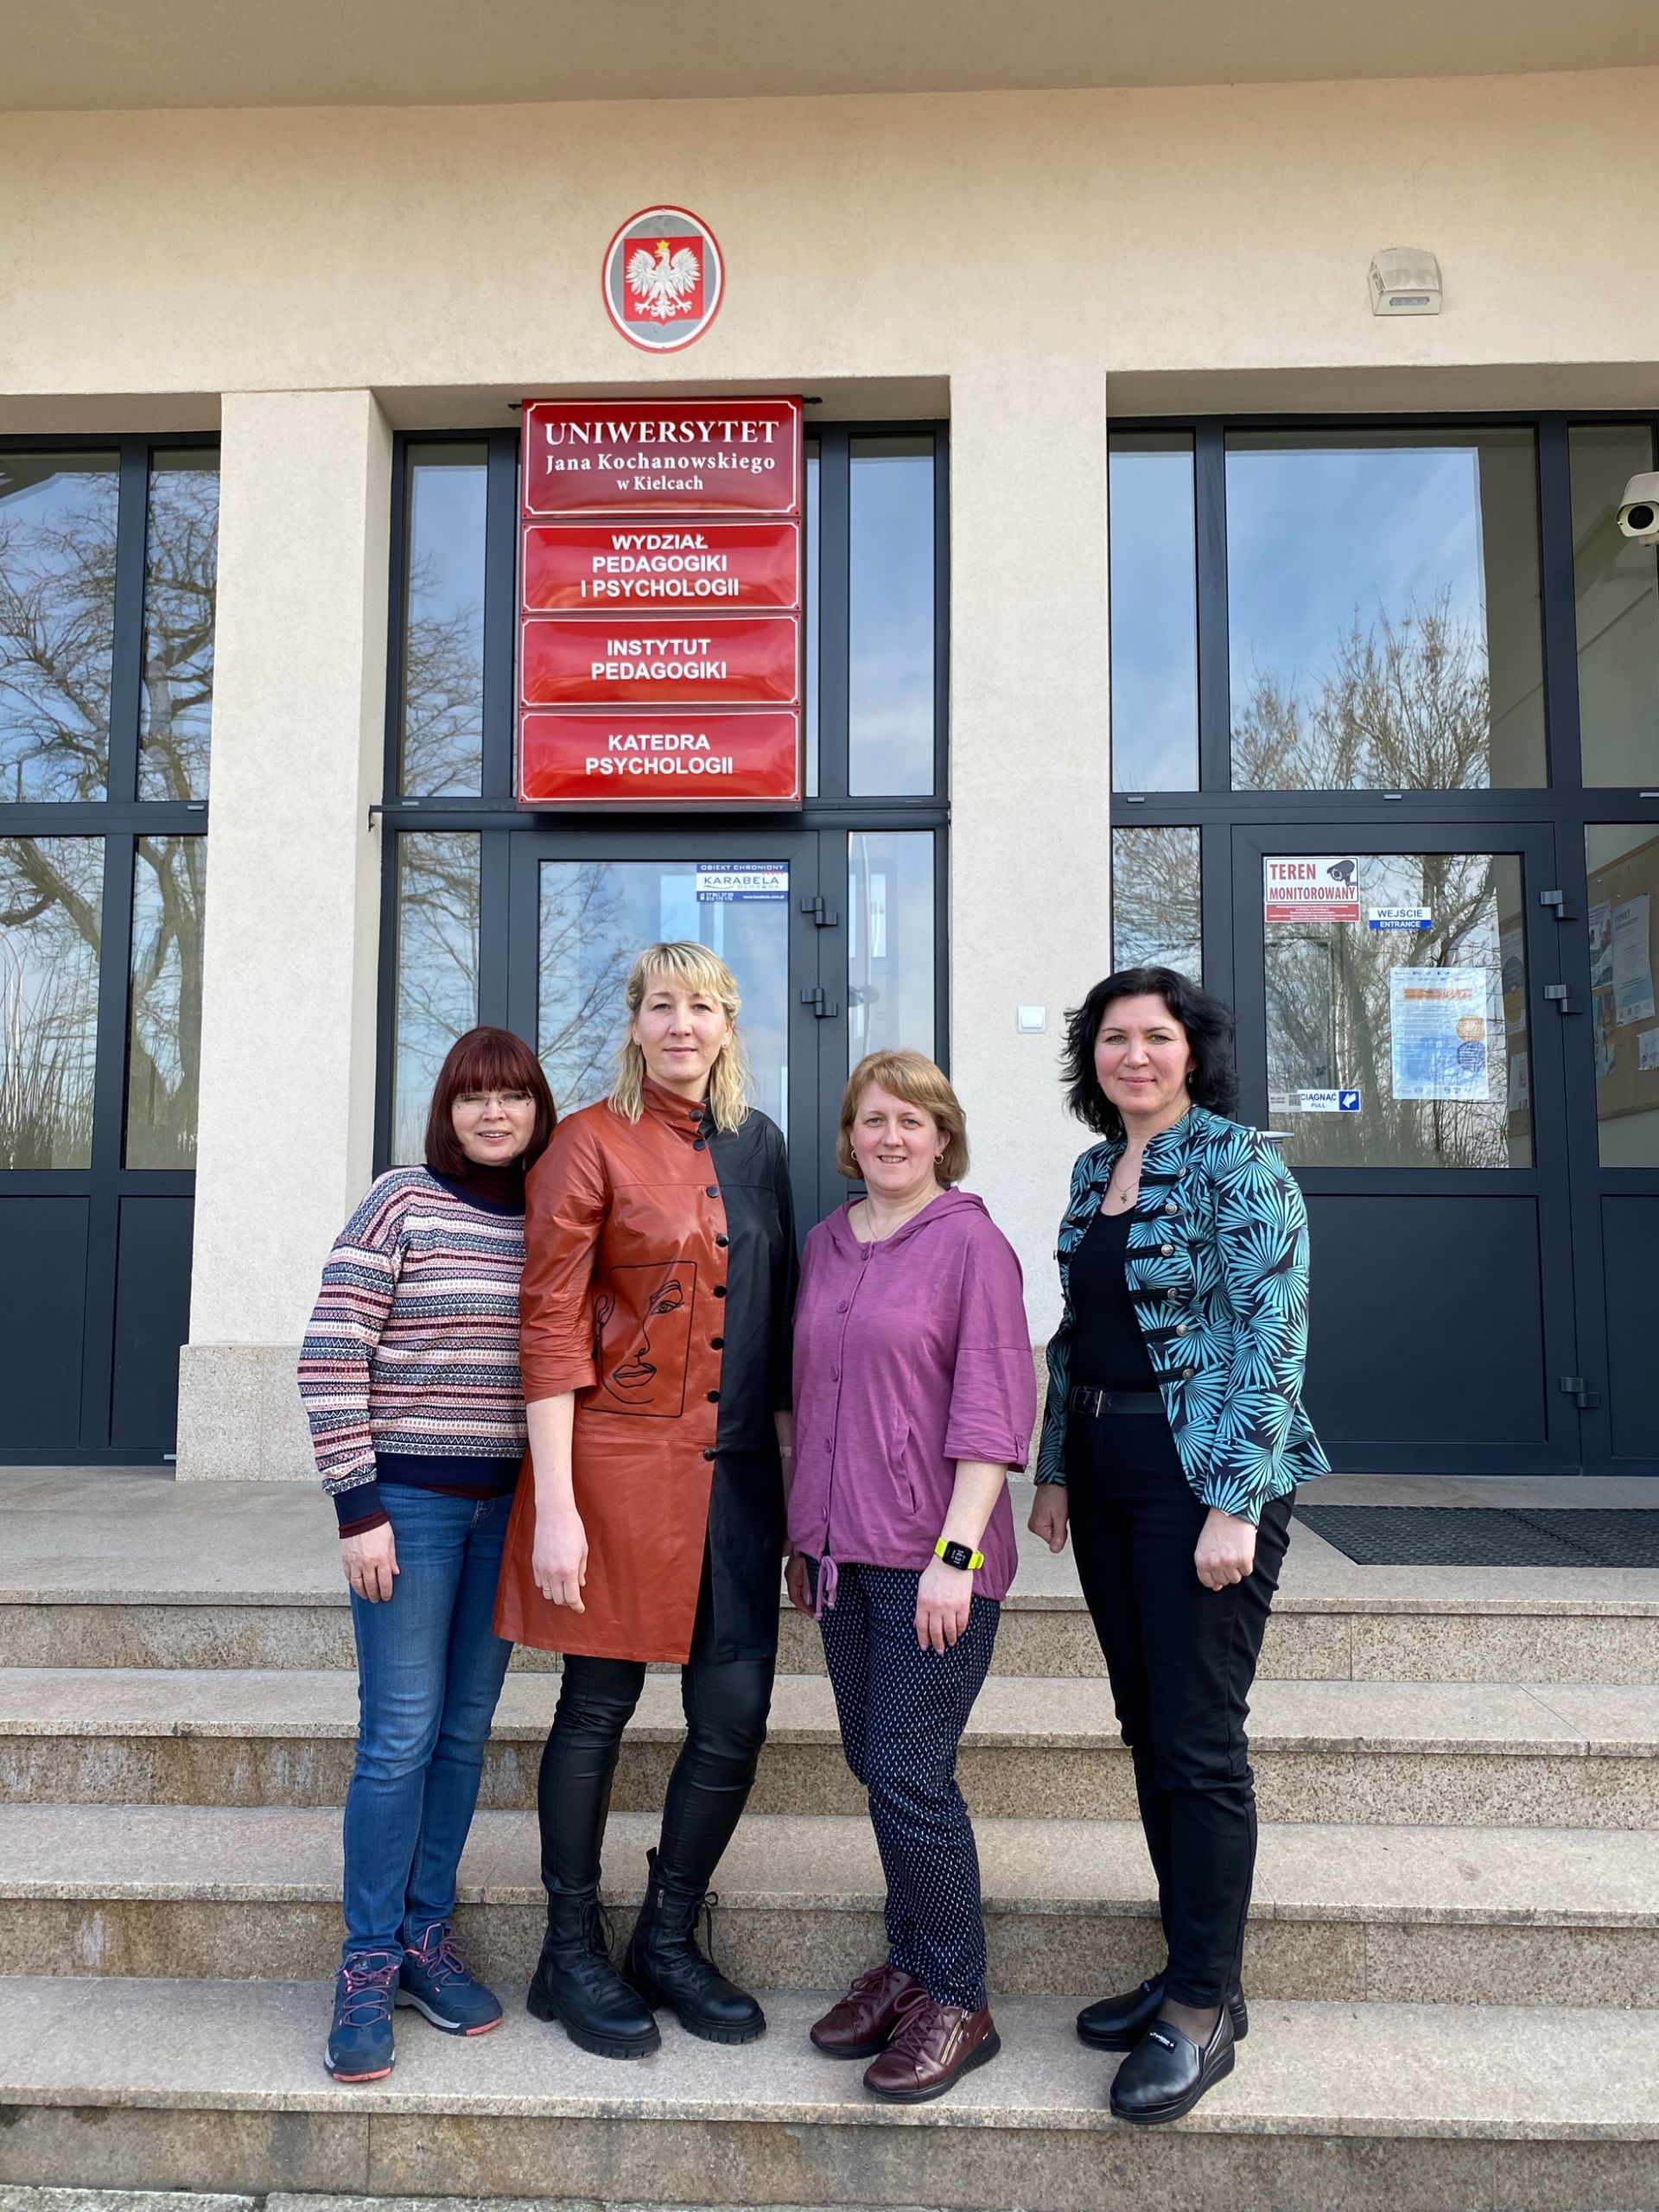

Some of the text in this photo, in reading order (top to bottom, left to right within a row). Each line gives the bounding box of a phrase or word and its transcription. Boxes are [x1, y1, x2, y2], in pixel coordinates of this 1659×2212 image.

[544, 420, 779, 446] UNIWERSYTET
[546, 452, 776, 475] Jana Kochanowskiego
[617, 475, 704, 492] w Kielcach
[612, 534, 709, 551] WYDZIAŁ
[592, 555, 728, 574] PEDAGOGIKI
[581, 578, 740, 598] I PSYCHOLOGII
[607, 639, 711, 657] INSTYTUT
[591, 662, 728, 681] PEDAGOGIKI
[608, 734, 711, 752] KATEDRA
[585, 757, 734, 776] PSYCHOLOGII
[703, 876, 779, 885] KARABELA
[1269, 863, 1316, 880] TEREN
[1269, 887, 1355, 900] MONITOROWANY
[1377, 908, 1423, 918] WEJŚCIE
